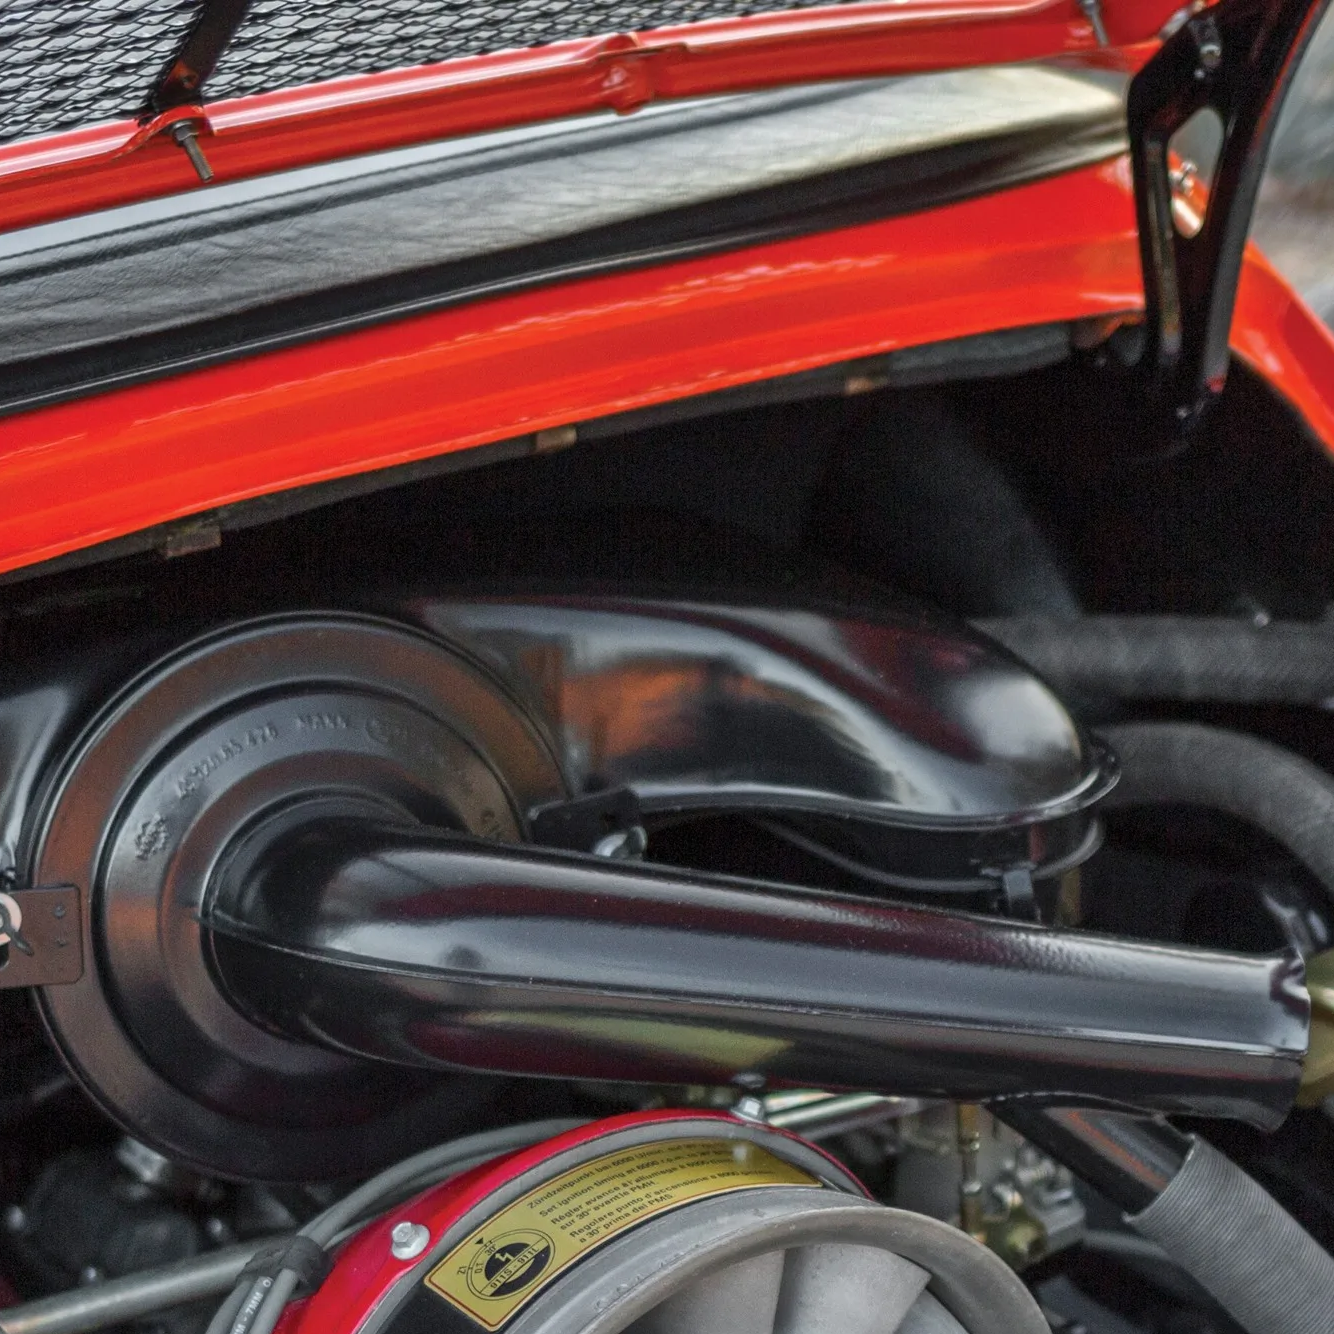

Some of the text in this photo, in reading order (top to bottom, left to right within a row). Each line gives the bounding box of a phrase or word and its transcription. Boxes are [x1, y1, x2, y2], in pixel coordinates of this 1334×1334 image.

[539, 1206, 558, 1218] Set
[559, 1185, 594, 1208] ignition
[594, 1172, 626, 1188] timing
[551, 1204, 583, 1225] Régler
[585, 1186, 620, 1206] avance
[560, 1218, 576, 1231] sur
[569, 1211, 614, 1238] Regolare
[616, 1196, 643, 1212] punto
[603, 1212, 631, 1229] prima
[632, 1202, 648, 1213] del
[491, 1269, 512, 1289] 911S
[245, 1292, 264, 1318] 7MM
